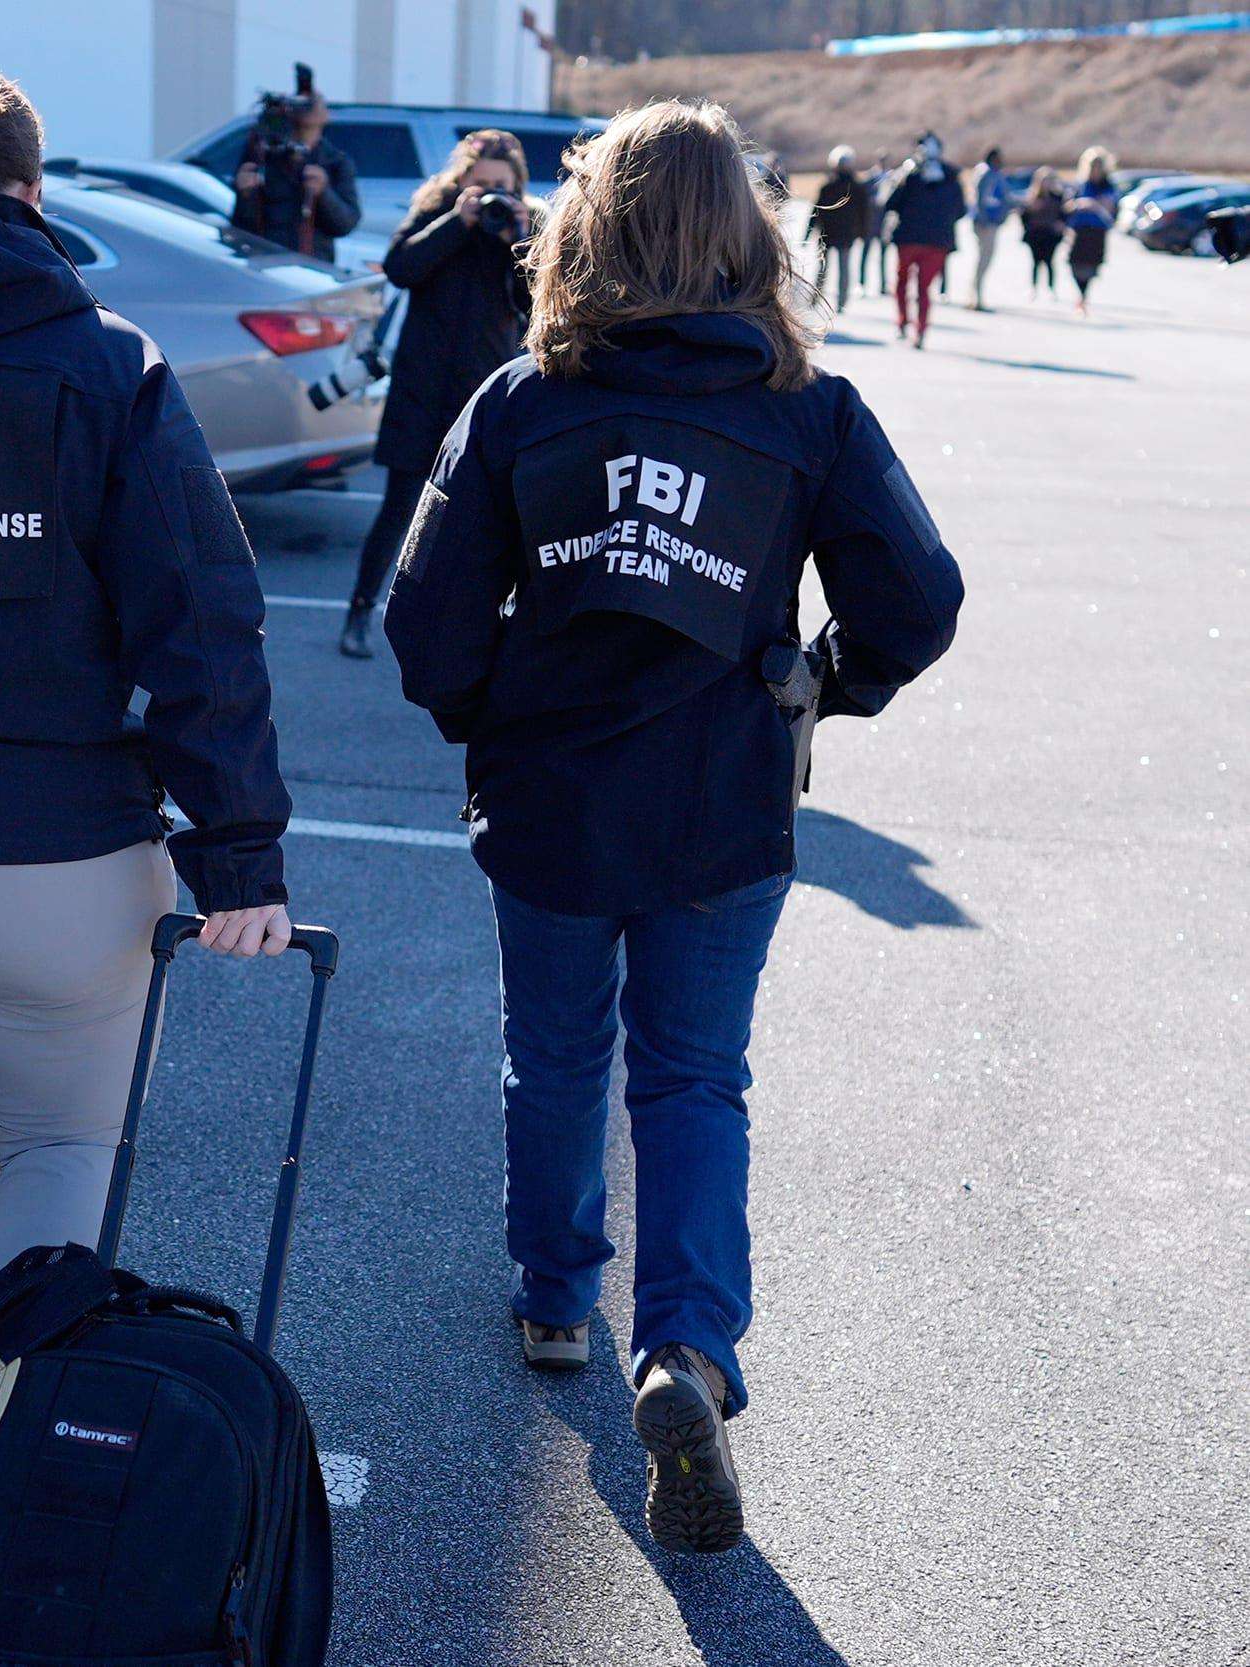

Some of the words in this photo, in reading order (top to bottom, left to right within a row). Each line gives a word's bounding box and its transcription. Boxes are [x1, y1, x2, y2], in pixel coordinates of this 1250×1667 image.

[605, 454, 706, 526] FBI
[604, 550, 670, 586] TEAM
[645, 523, 747, 593] RESPONSE
[70, 1425, 127, 1445] tamrac
